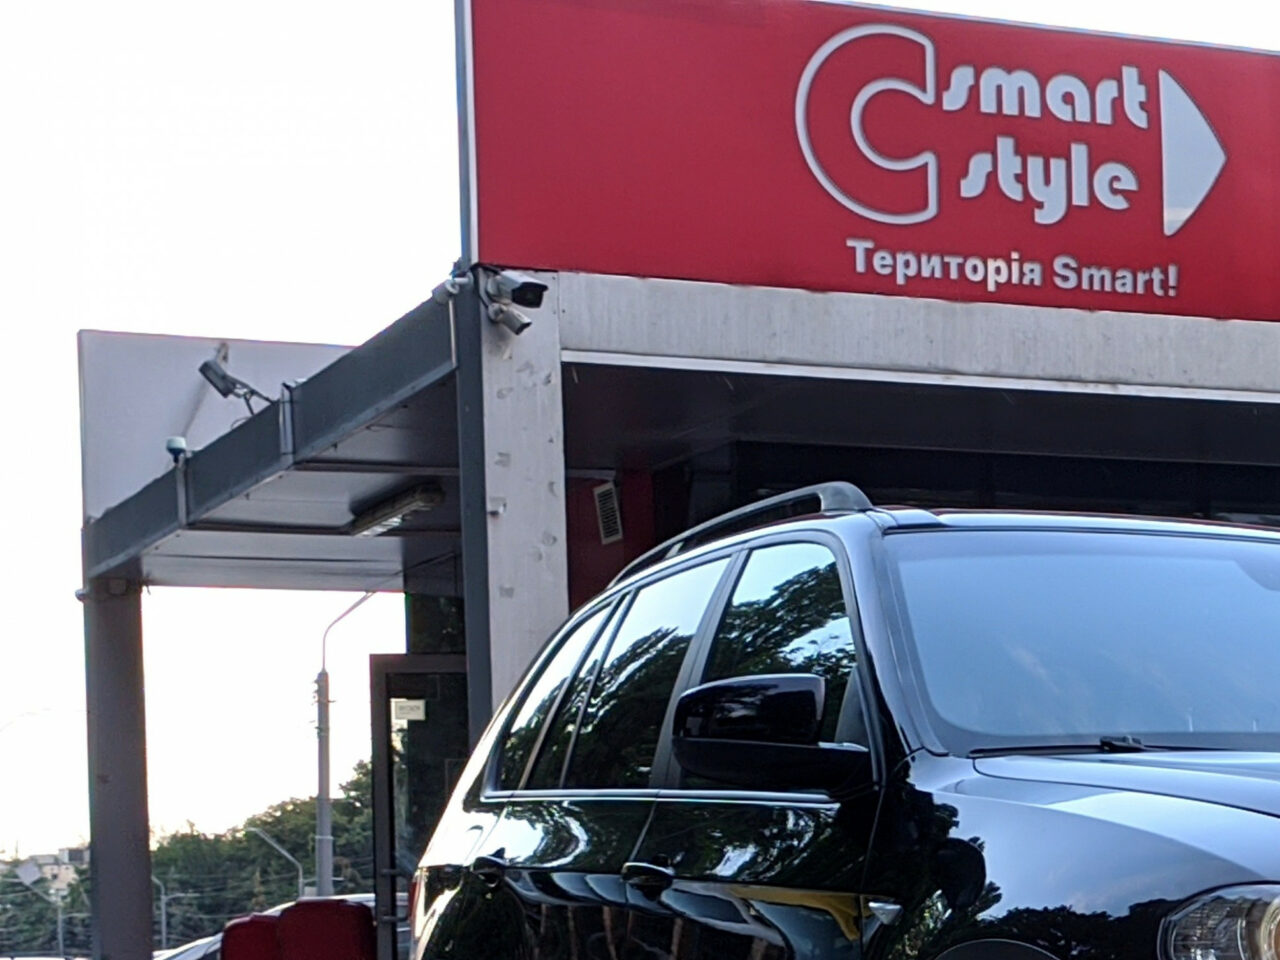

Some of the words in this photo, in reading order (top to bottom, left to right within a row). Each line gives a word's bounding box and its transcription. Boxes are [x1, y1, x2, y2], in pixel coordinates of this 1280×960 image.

[942, 65, 1149, 129] smart
[960, 136, 1139, 225] style
[846, 239, 1042, 292] Територія
[1053, 252, 1179, 297] Smart!
